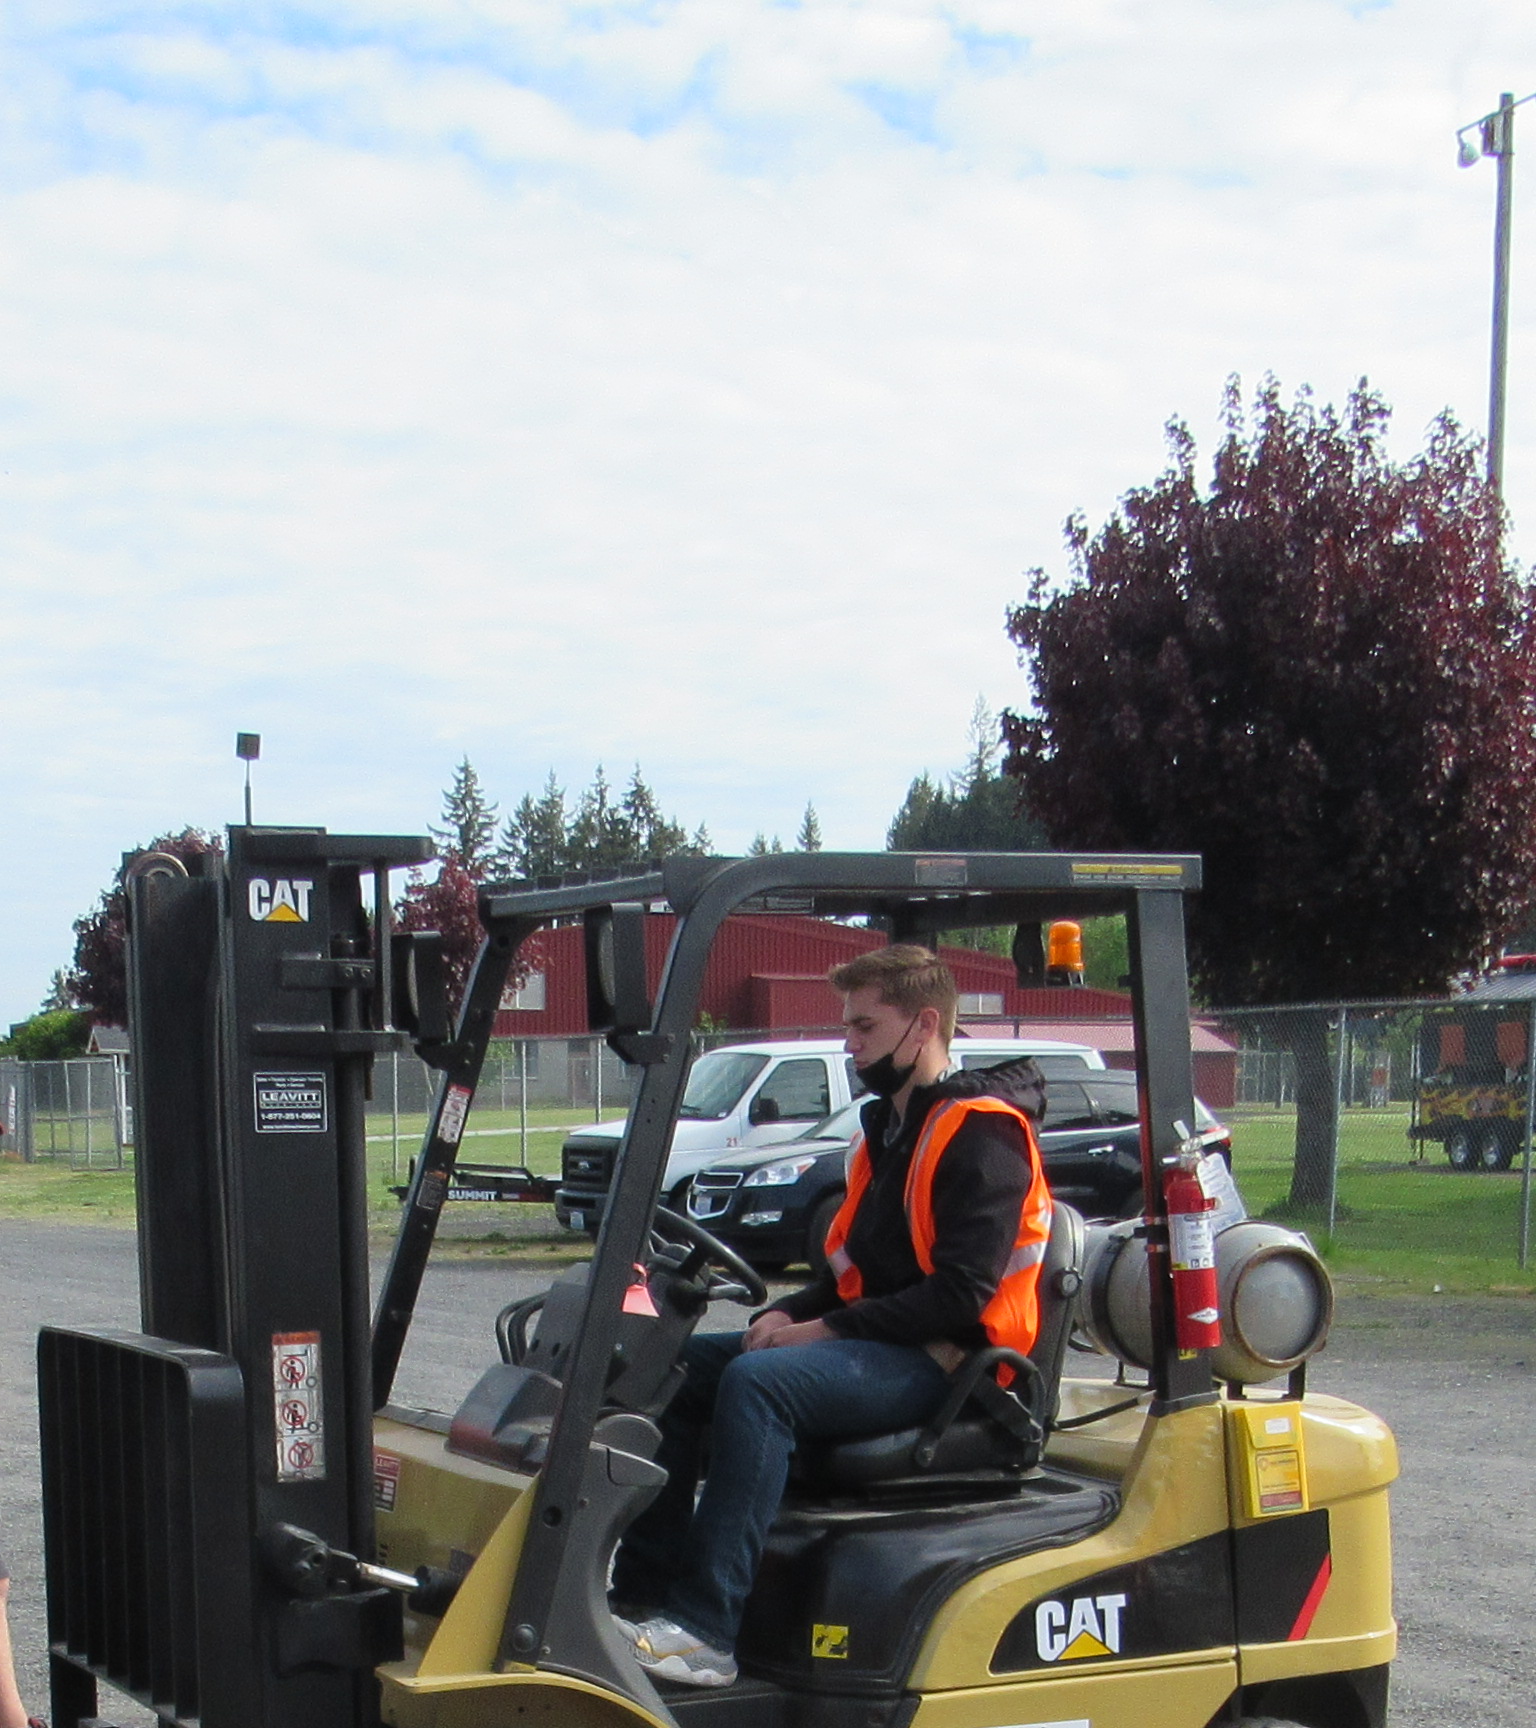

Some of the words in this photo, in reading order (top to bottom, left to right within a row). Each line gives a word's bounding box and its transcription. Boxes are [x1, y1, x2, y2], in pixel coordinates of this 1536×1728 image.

[248, 878, 314, 922] CAT
[262, 1092, 317, 1101] LEAVITT
[447, 1190, 497, 1200] SUMMIT
[1035, 1593, 1126, 1662] CAT
